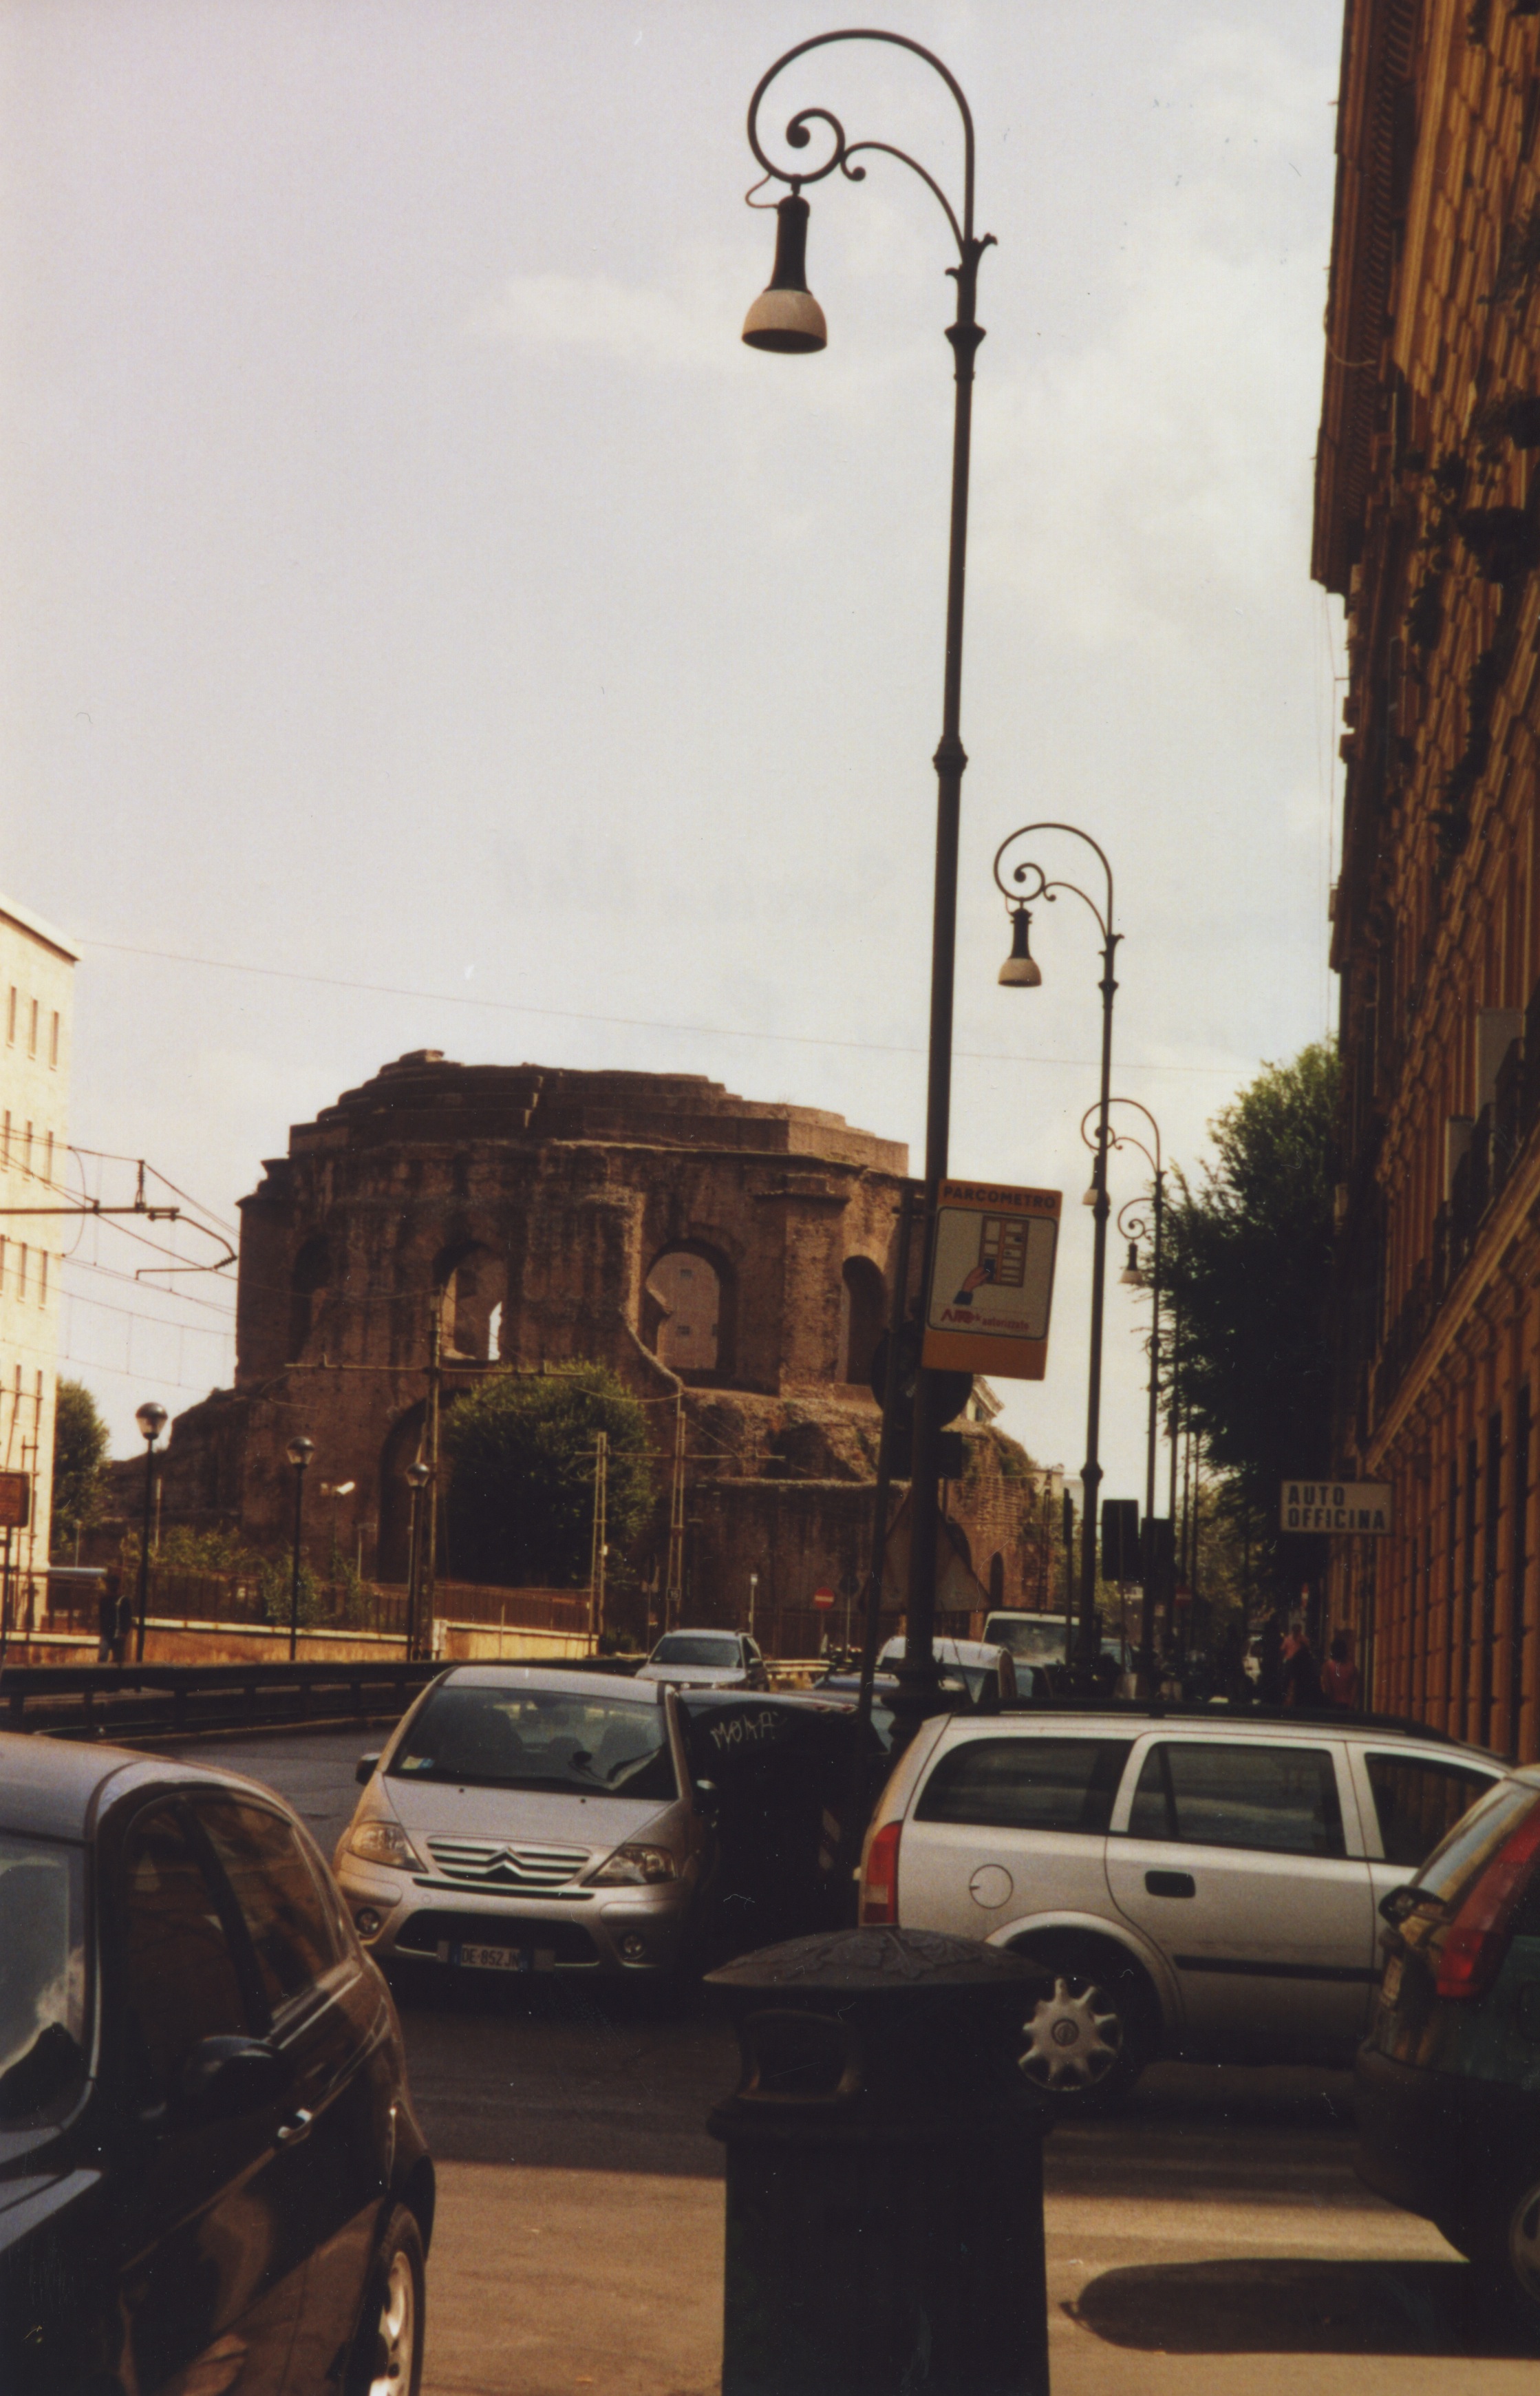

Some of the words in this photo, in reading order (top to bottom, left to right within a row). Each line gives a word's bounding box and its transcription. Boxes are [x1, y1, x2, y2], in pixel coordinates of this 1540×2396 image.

[943, 1185, 1056, 1209] PARCOMETRO
[1287, 1485, 1345, 1506] AUTO
[1287, 1507, 1385, 1529] OFFICINA
